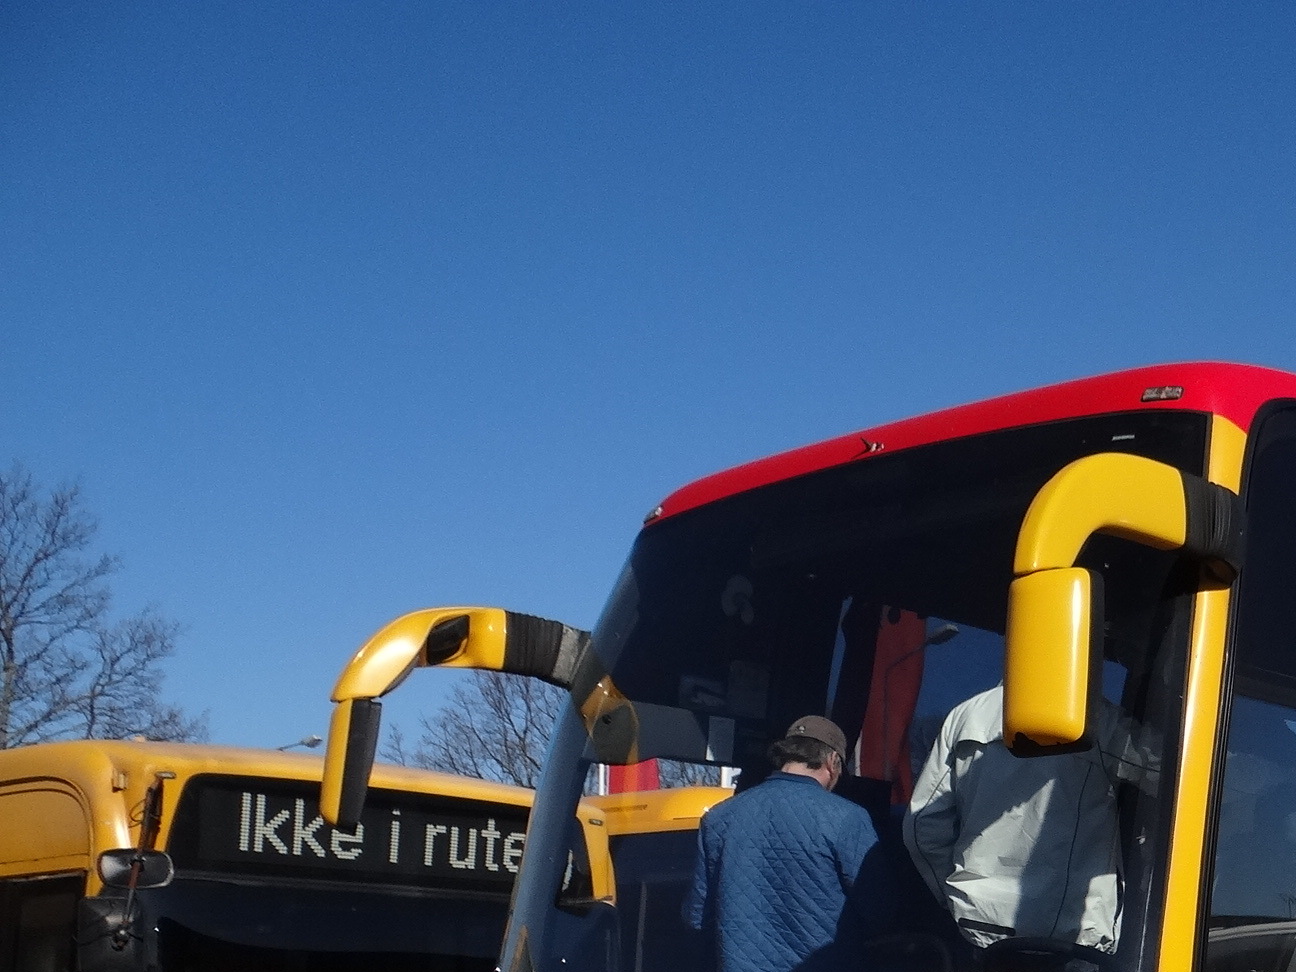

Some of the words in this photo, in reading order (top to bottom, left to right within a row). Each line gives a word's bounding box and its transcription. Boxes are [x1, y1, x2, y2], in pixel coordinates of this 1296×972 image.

[239, 792, 364, 860] Ikke
[389, 809, 400, 864] i
[424, 818, 527, 873] rute
